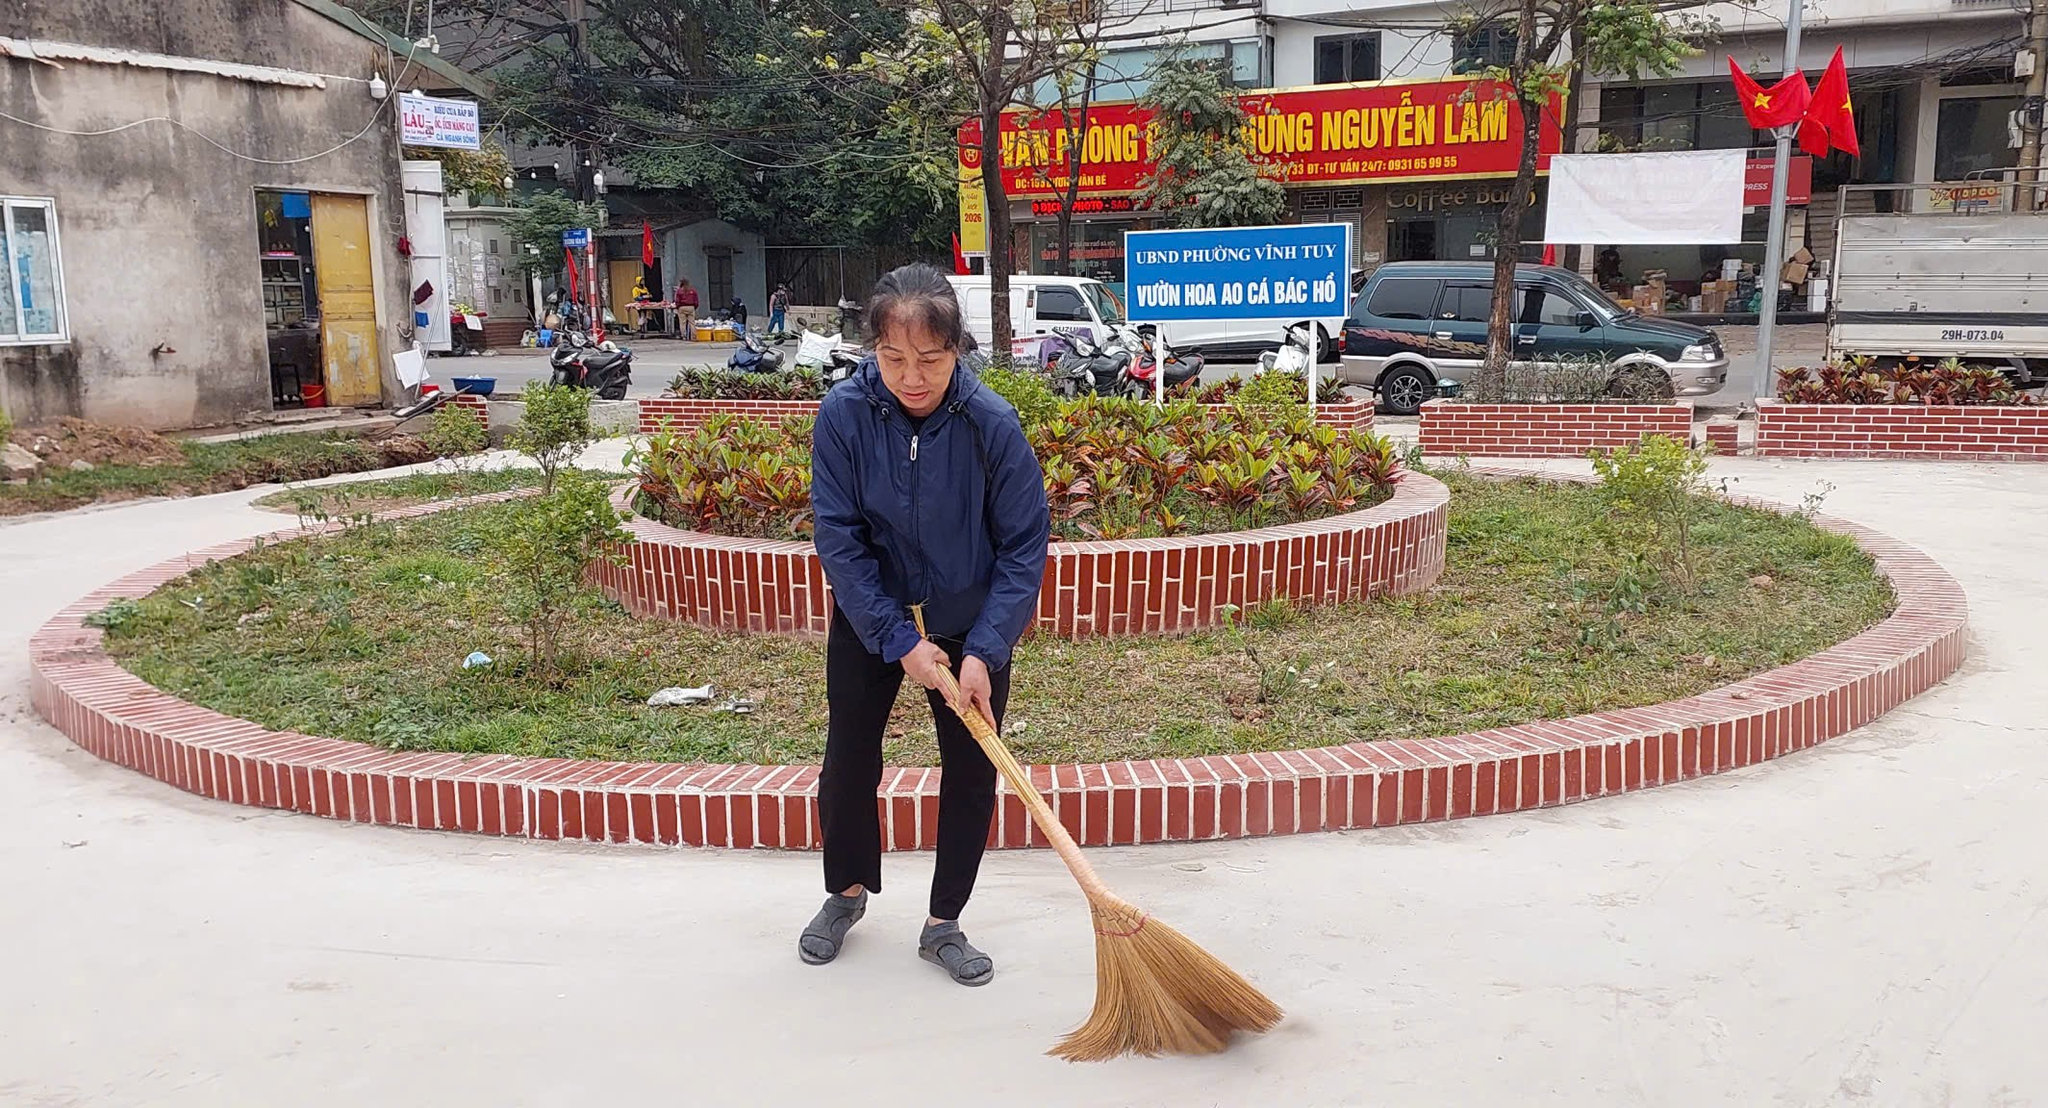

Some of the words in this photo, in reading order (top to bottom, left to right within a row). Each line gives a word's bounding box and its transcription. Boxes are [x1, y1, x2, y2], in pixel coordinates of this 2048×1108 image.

[1321, 91, 1436, 151] NGUYỄN
[1340, 157, 1359, 173] VẤN
[1361, 160, 1387, 172] 24/7:
[1388, 158, 1413, 171] 0931
[1414, 157, 1428, 169] 65
[1429, 156, 1442, 168] 99
[1443, 155, 1458, 168] 55
[1111, 200, 1130, 211] SAO
[1387, 186, 1467, 212] Coffee
[964, 213, 982, 223] 2026
[1136, 250, 1179, 265] UBND
[1182, 244, 1251, 263] PHƯỜNG
[1254, 243, 1297, 261] VĨNH
[1301, 244, 1337, 259] TUY
[1136, 279, 1181, 307] VƯỜN
[1184, 283, 1217, 306] HOA
[1221, 281, 1243, 306] AO
[1247, 277, 1270, 305] CÁ
[1274, 276, 1308, 304] BÁC
[1313, 271, 1336, 303] HỒ
[1941, 329, 2004, 341] 29H-073.04
